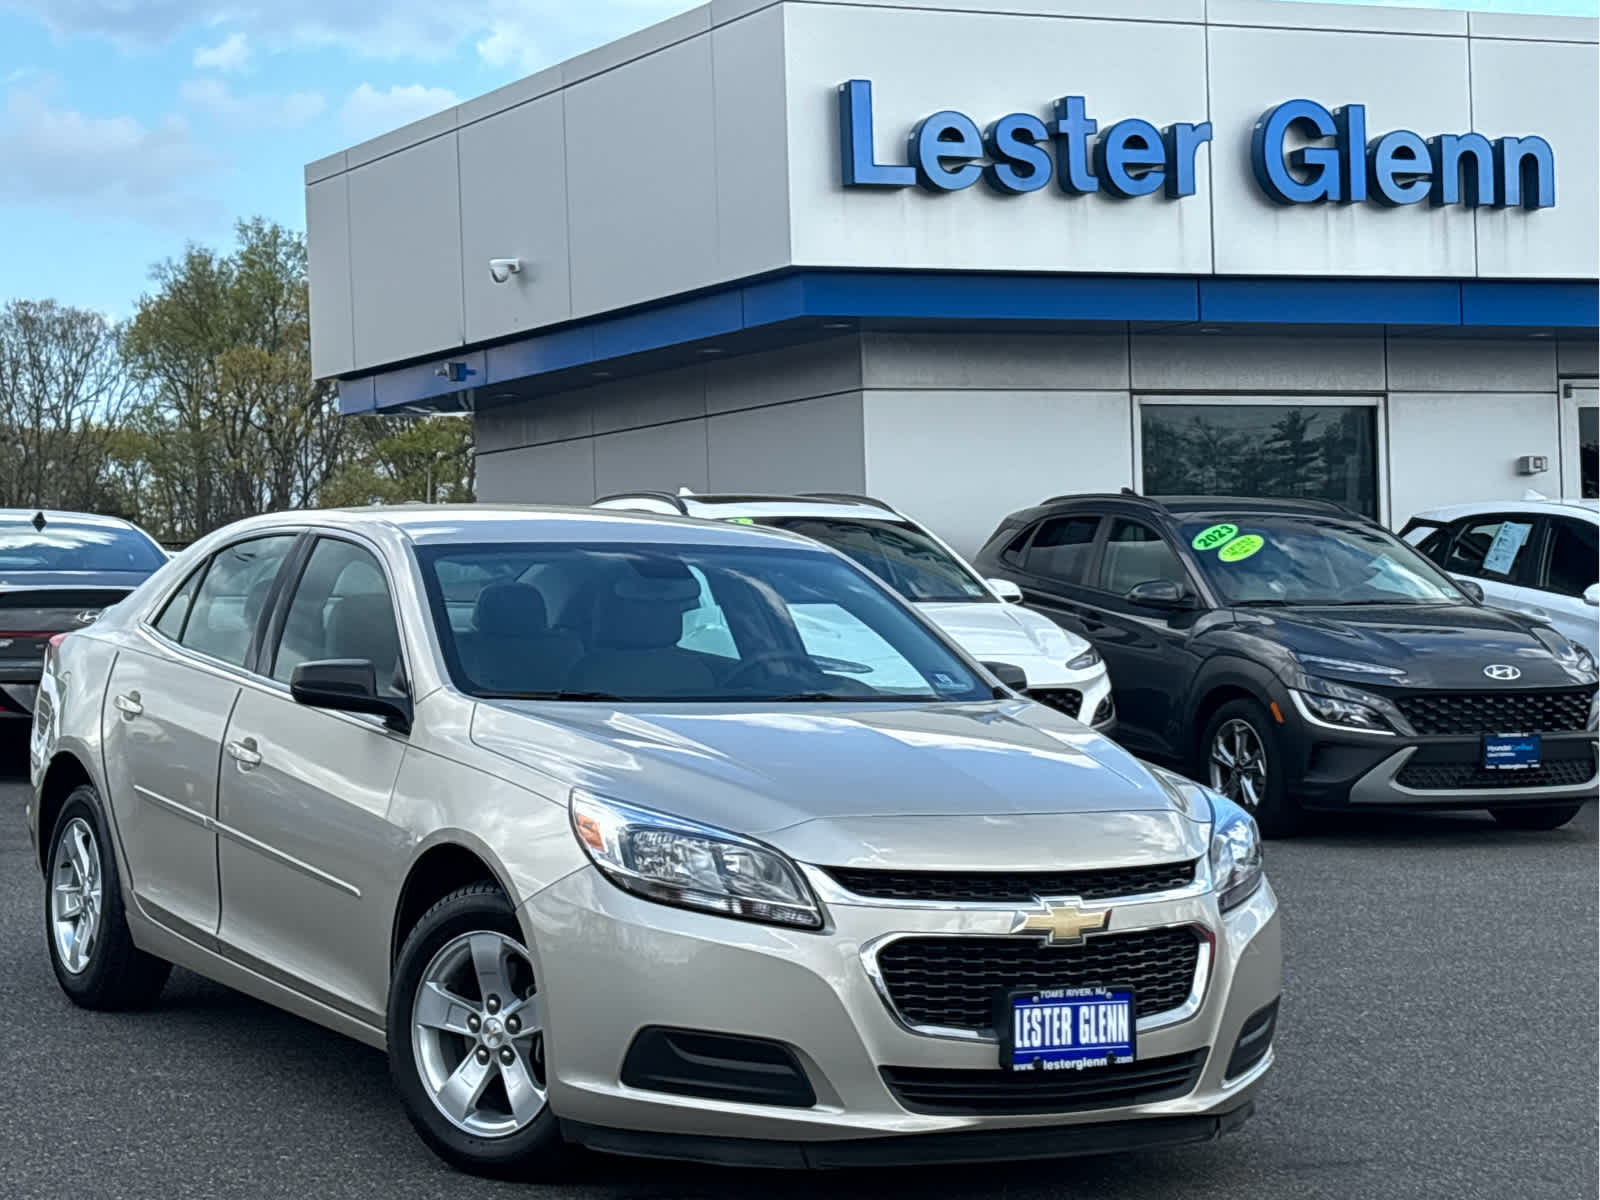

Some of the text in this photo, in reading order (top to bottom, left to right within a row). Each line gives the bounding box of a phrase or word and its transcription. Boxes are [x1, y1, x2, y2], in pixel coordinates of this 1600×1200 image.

[839, 79, 1556, 209] Lester Glenn
[1198, 525, 1234, 547] 2023
[1040, 989, 1065, 999] TOMS
[1014, 1003, 1129, 1048] LESTER GLENN
[1043, 1057, 1107, 1070] lesterglenn
